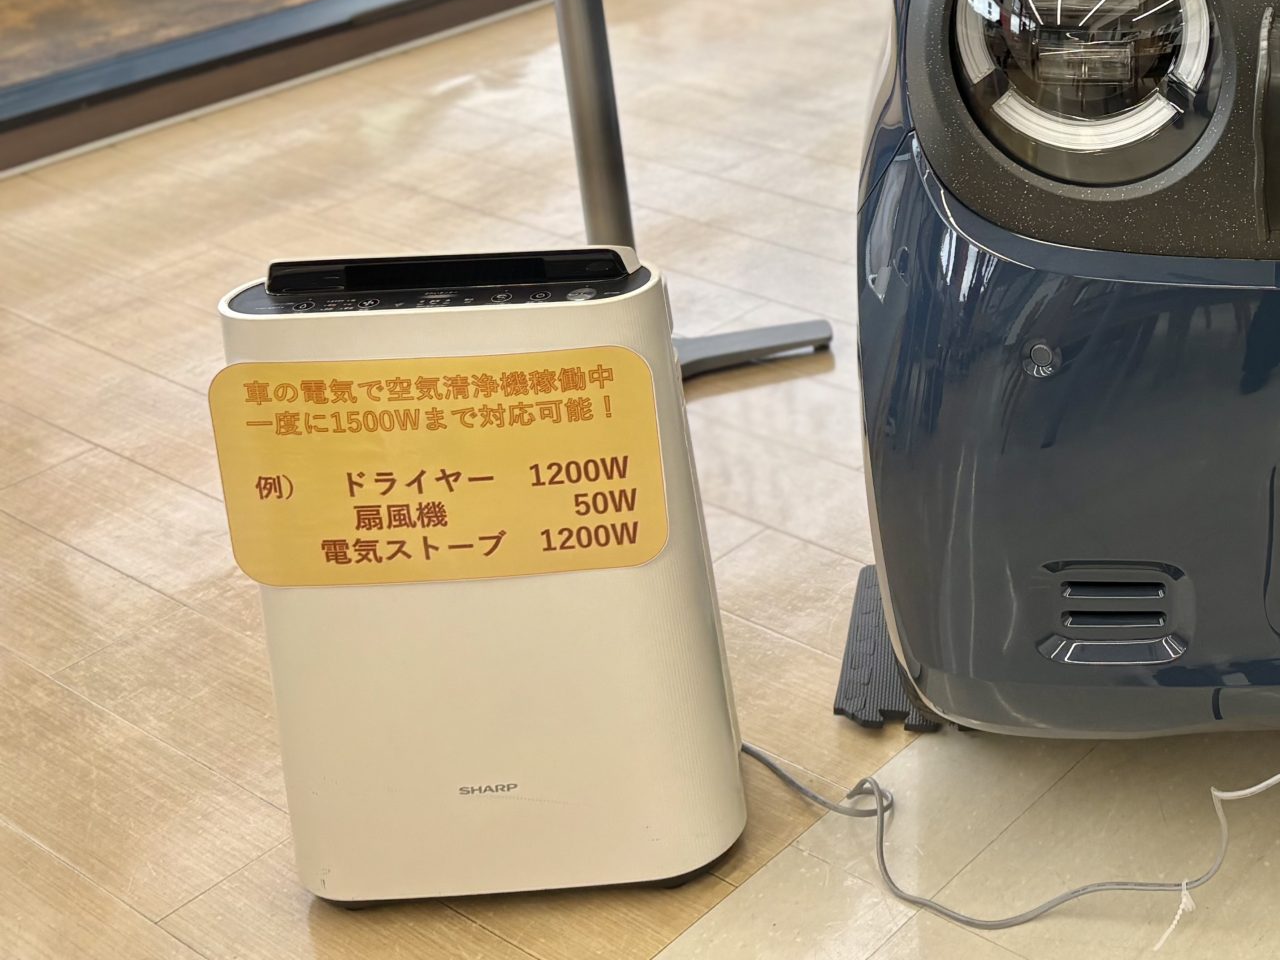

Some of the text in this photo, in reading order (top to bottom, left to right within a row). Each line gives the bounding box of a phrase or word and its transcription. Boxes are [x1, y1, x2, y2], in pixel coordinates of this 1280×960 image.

[243, 363, 615, 406] 車の電気で空気清浄機稼働中
[245, 395, 614, 437] 一度に1500Wまで対応可能！
[344, 467, 495, 498] ドライヤー
[529, 455, 629, 488] 1200W
[353, 487, 638, 532] 扇風機 50W
[321, 520, 640, 565] 電気ストーブ 1200W
[459, 783, 518, 795] SHARP
